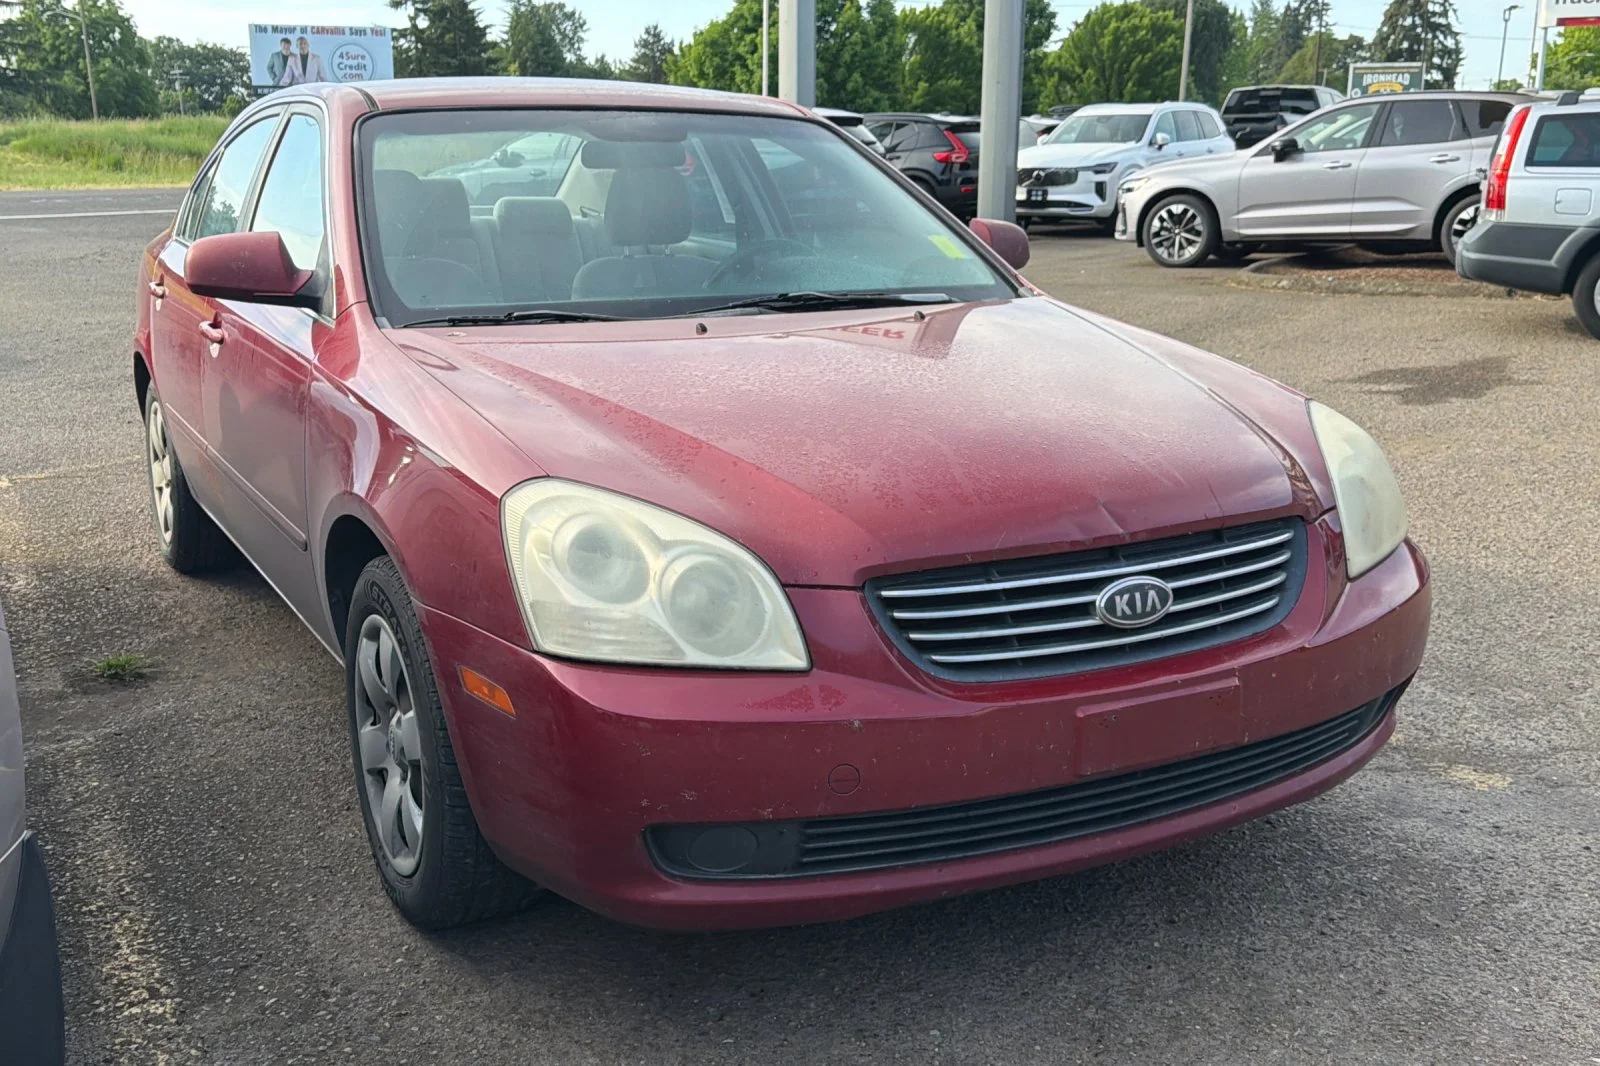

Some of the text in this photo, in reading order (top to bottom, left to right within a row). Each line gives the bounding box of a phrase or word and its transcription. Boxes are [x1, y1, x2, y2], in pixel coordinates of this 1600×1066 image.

[254, 25, 268, 34] The
[271, 25, 297, 35] Mayor
[300, 26, 308, 35] of
[349, 28, 368, 38] Says
[338, 52, 366, 61] 4Sure
[337, 62, 367, 71] Credit
[341, 72, 363, 80] .com
[1362, 73, 1411, 86] IRONHEAD
[1114, 589, 1162, 617] KIA
